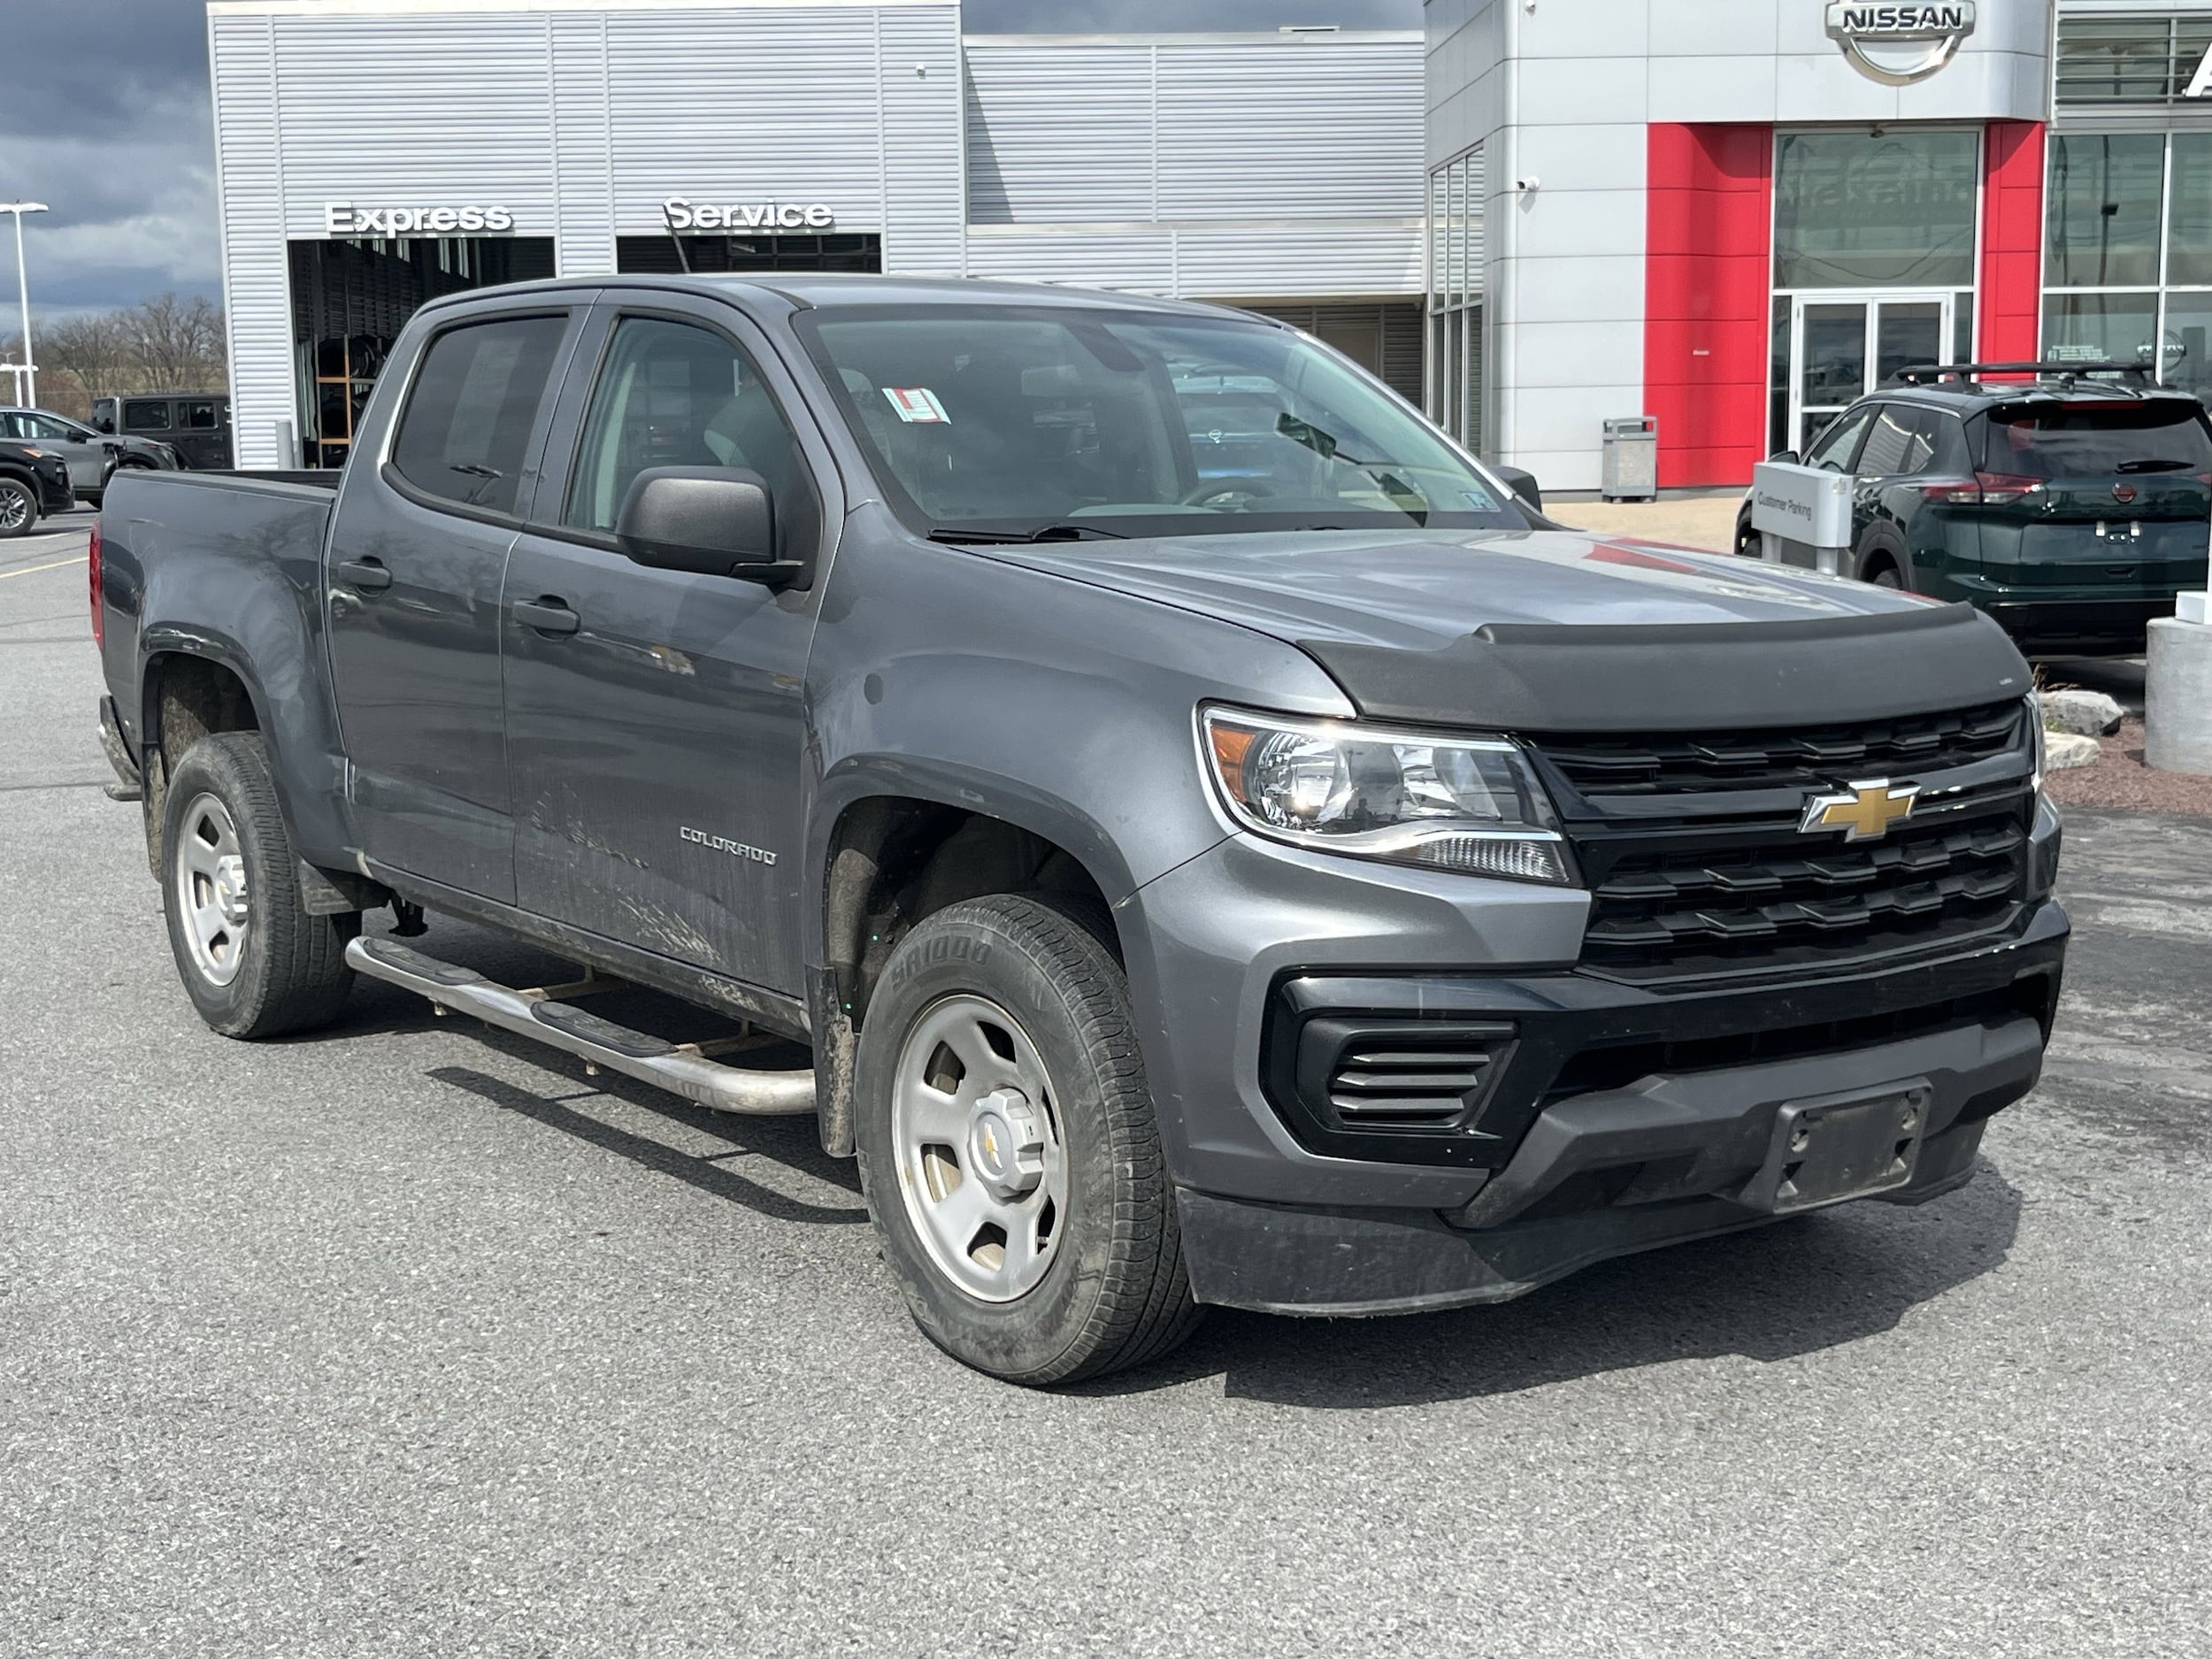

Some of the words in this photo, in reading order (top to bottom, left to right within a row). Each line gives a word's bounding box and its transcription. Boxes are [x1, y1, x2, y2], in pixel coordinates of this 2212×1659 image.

[1843, 7, 1962, 32] NISSAN
[325, 202, 513, 238] Express
[663, 196, 834, 229] Service
[1757, 491, 1786, 511] Customer
[1787, 499, 1812, 521] Parking
[680, 826, 778, 866] COLORADO
